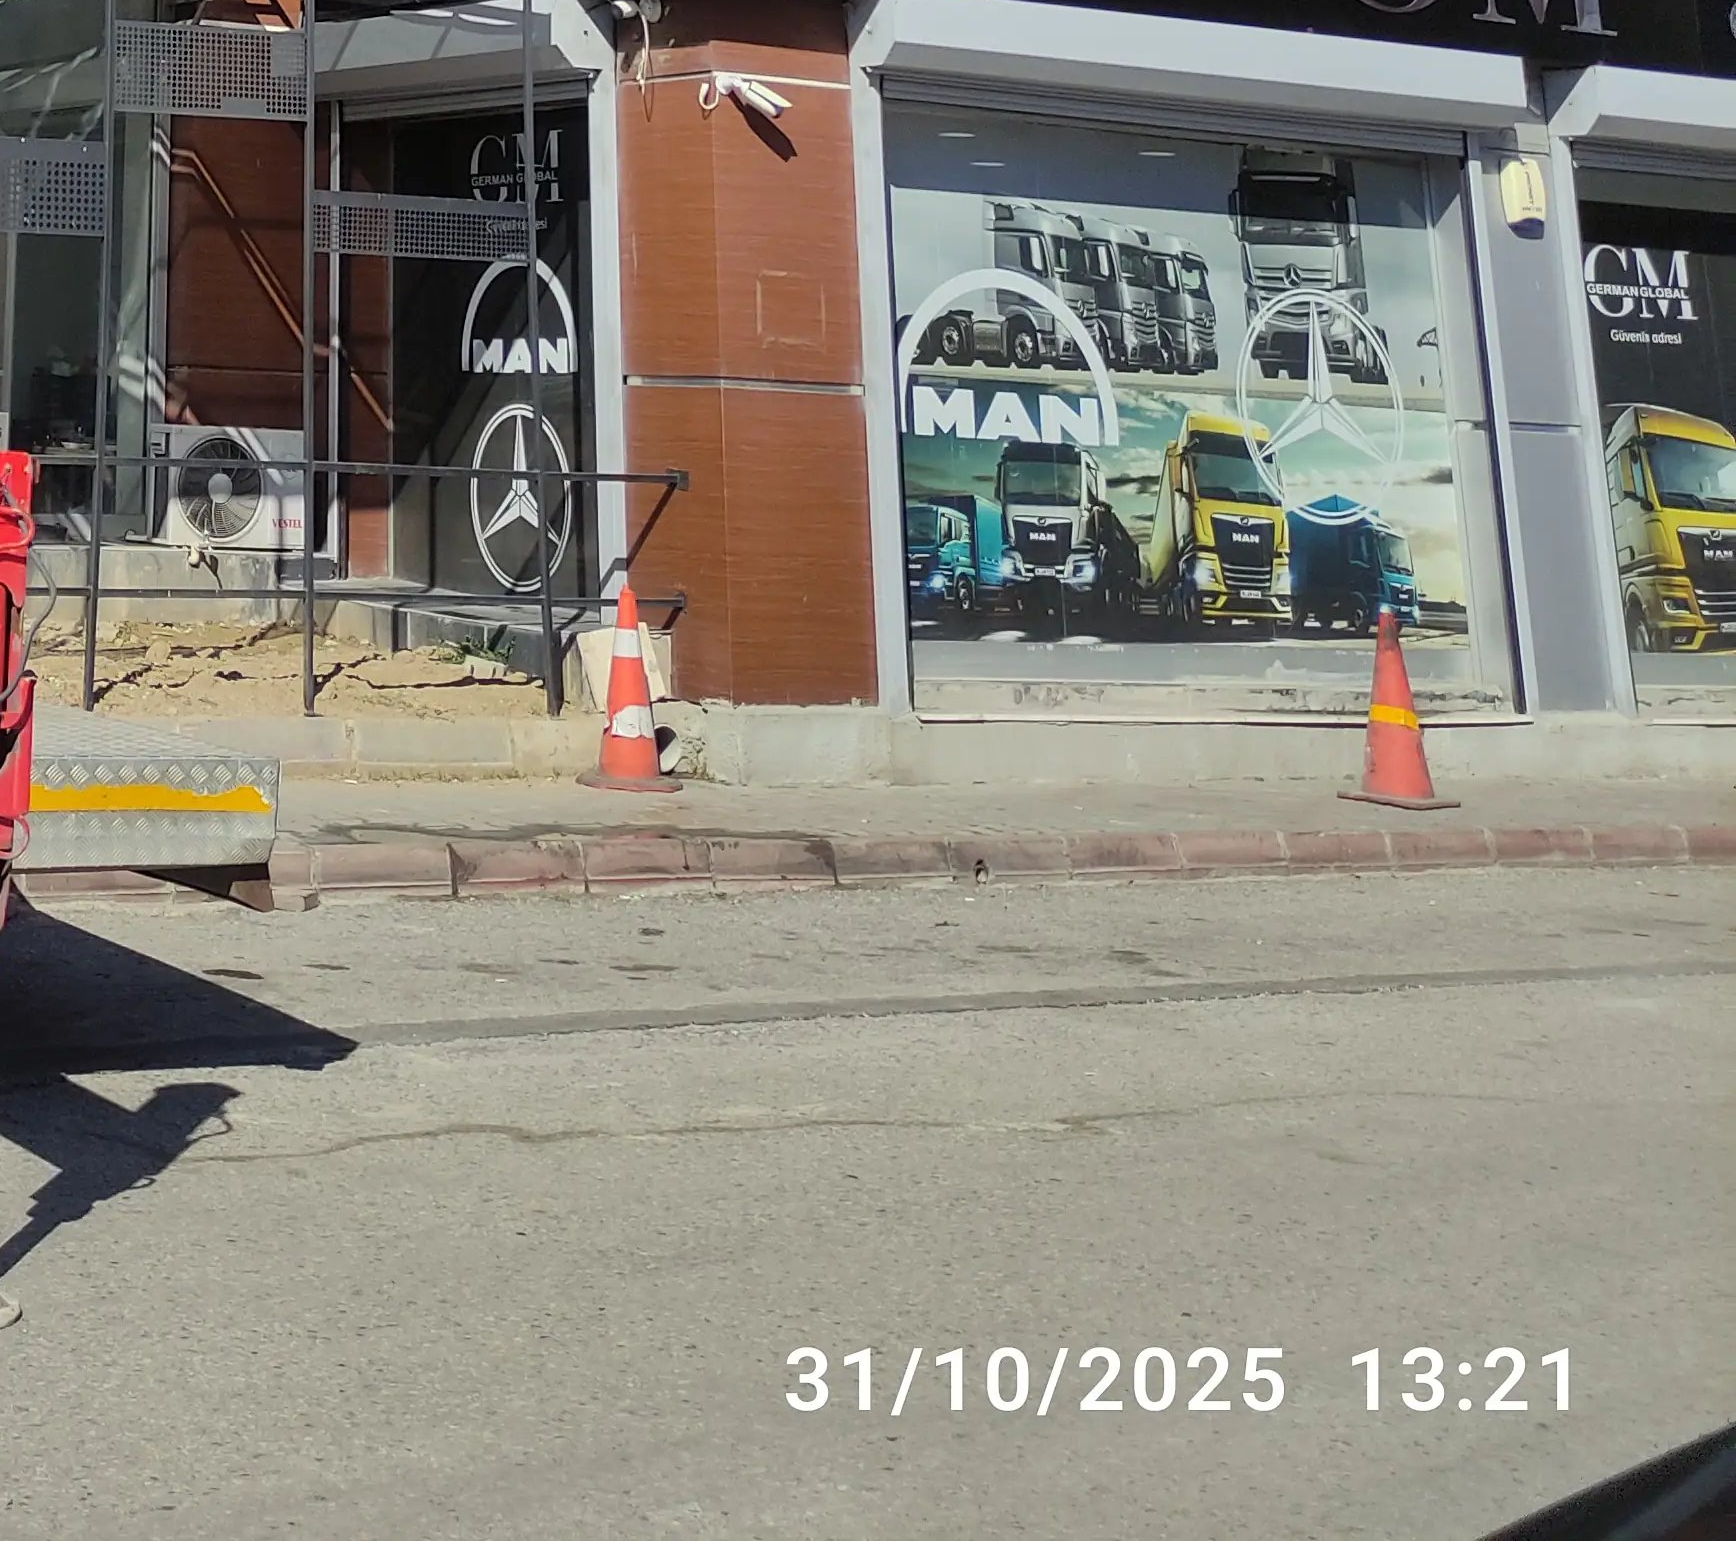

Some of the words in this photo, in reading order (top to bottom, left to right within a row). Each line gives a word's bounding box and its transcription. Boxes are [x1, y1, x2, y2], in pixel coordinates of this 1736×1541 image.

[471, 173, 514, 187] GERMAN
[1586, 283, 1638, 297] GERMAN
[1640, 287, 1690, 299] GLOBAL
[472, 338, 569, 374] MAN
[912, 385, 1101, 447] MAN
[1232, 532, 1261, 544] MAN
